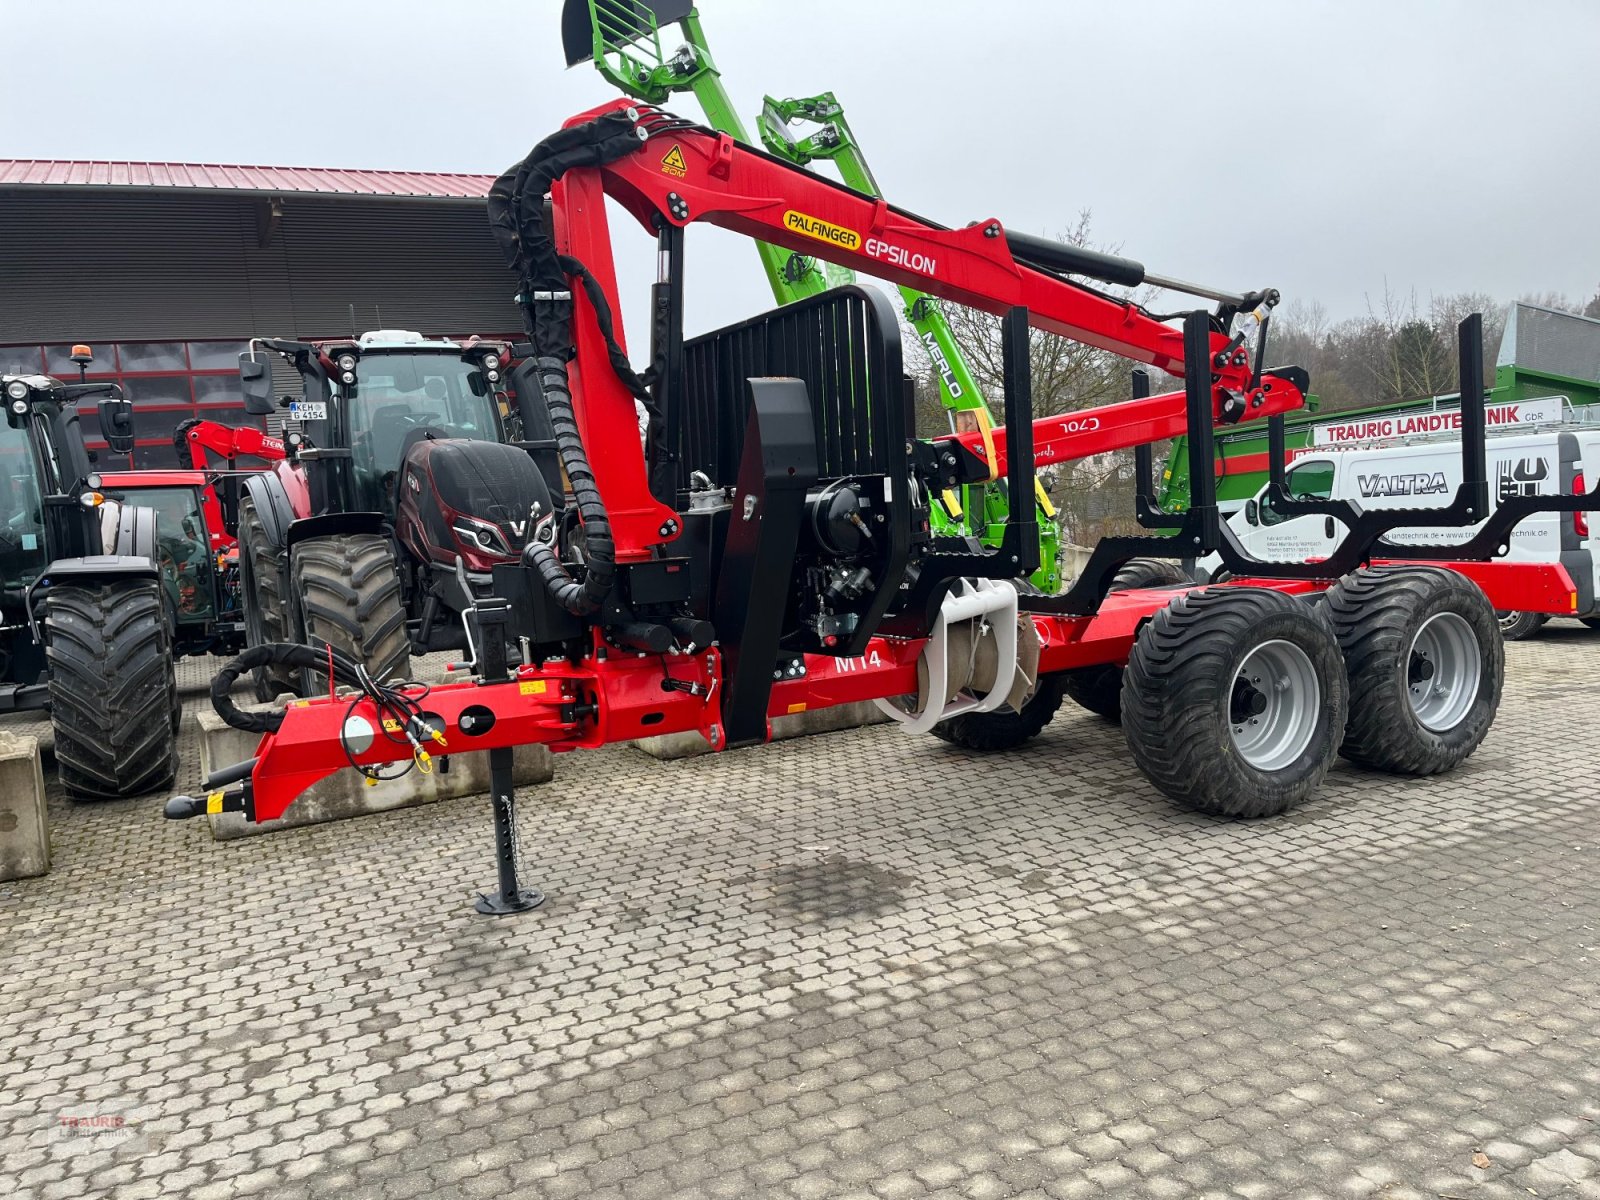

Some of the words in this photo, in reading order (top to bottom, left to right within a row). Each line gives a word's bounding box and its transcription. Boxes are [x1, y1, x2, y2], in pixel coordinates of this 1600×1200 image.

[788, 213, 857, 247] PALFINGER
[865, 238, 936, 275] EPSILON
[922, 331, 962, 398] MERLO
[296, 403, 313, 411] KEH
[1059, 417, 1100, 433] C70L
[1326, 420, 1392, 442] TRAURIG
[1396, 405, 1520, 434] LANDTENIK
[1524, 412, 1544, 422] GbR
[1357, 471, 1449, 498] VALTRA
